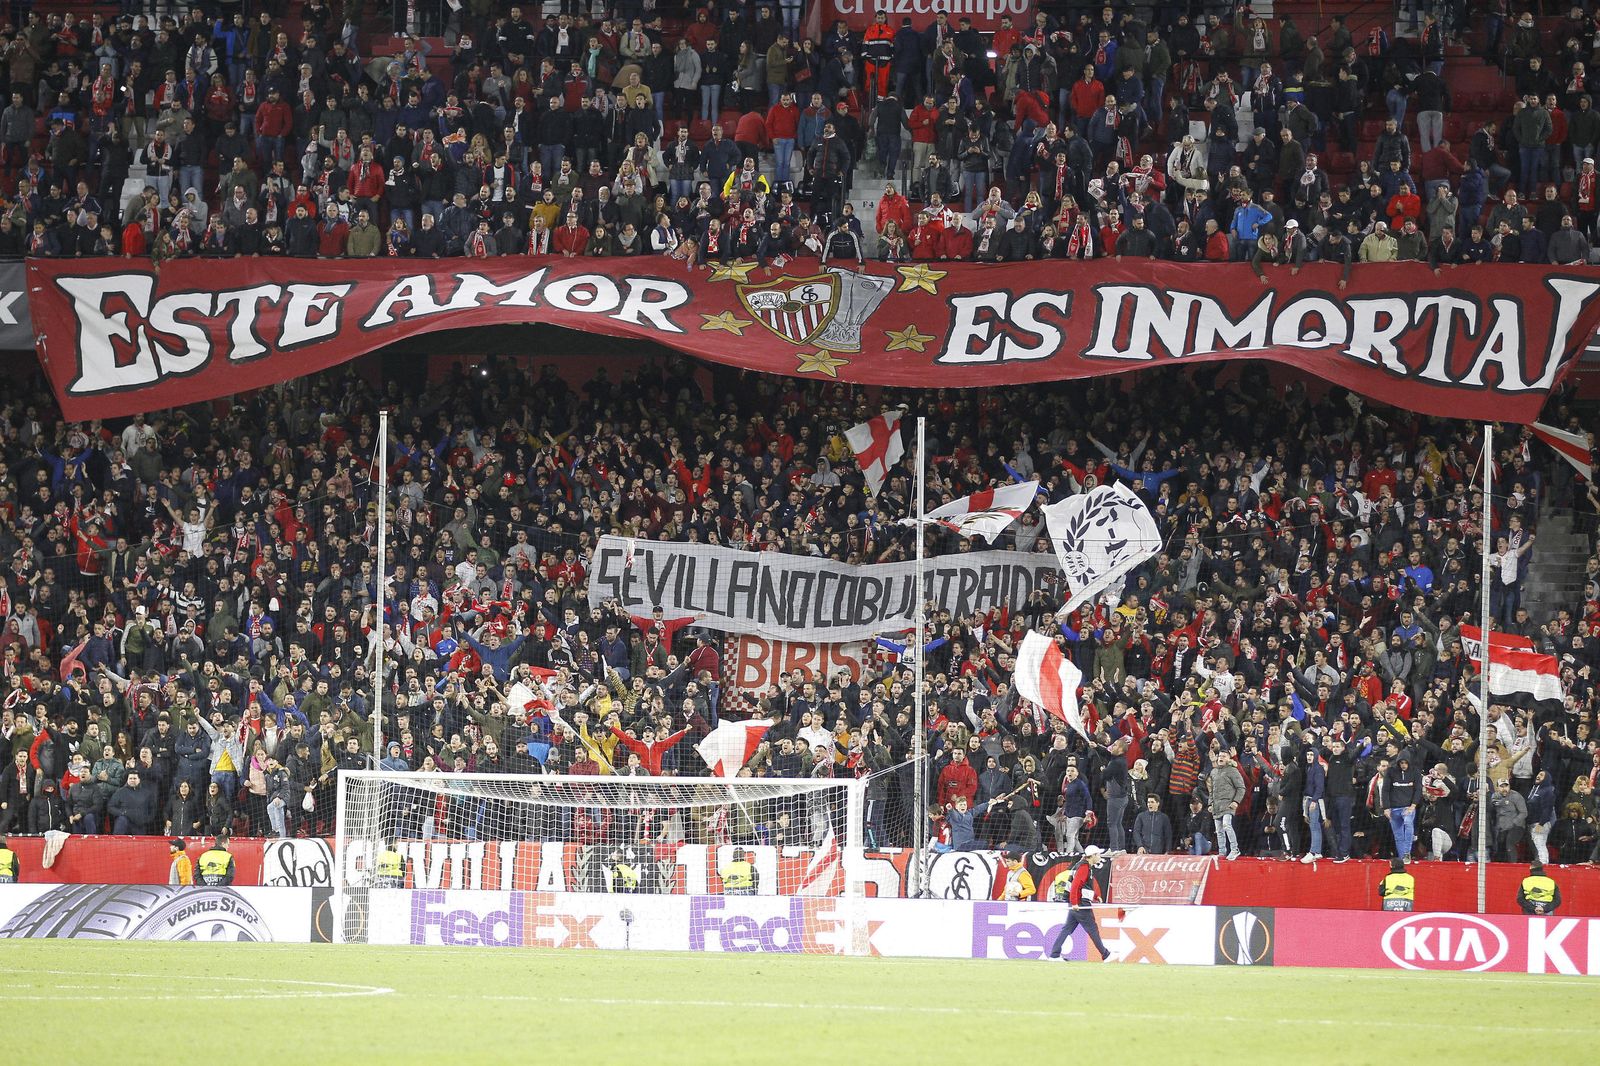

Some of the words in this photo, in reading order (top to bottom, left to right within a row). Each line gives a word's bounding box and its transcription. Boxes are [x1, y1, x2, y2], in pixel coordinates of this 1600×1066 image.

[56, 272, 353, 393] ESTE
[362, 266, 689, 333] AMOR
[936, 291, 1070, 363] ES
[735, 634, 861, 690] BIRIS
[1116, 856, 1207, 873] Madrid
[1150, 880, 1185, 893] 1975
[410, 890, 604, 951] FedEx
[689, 896, 886, 956] FedEx
[972, 902, 1170, 965] FedEx
[1403, 926, 1488, 963] KIA
